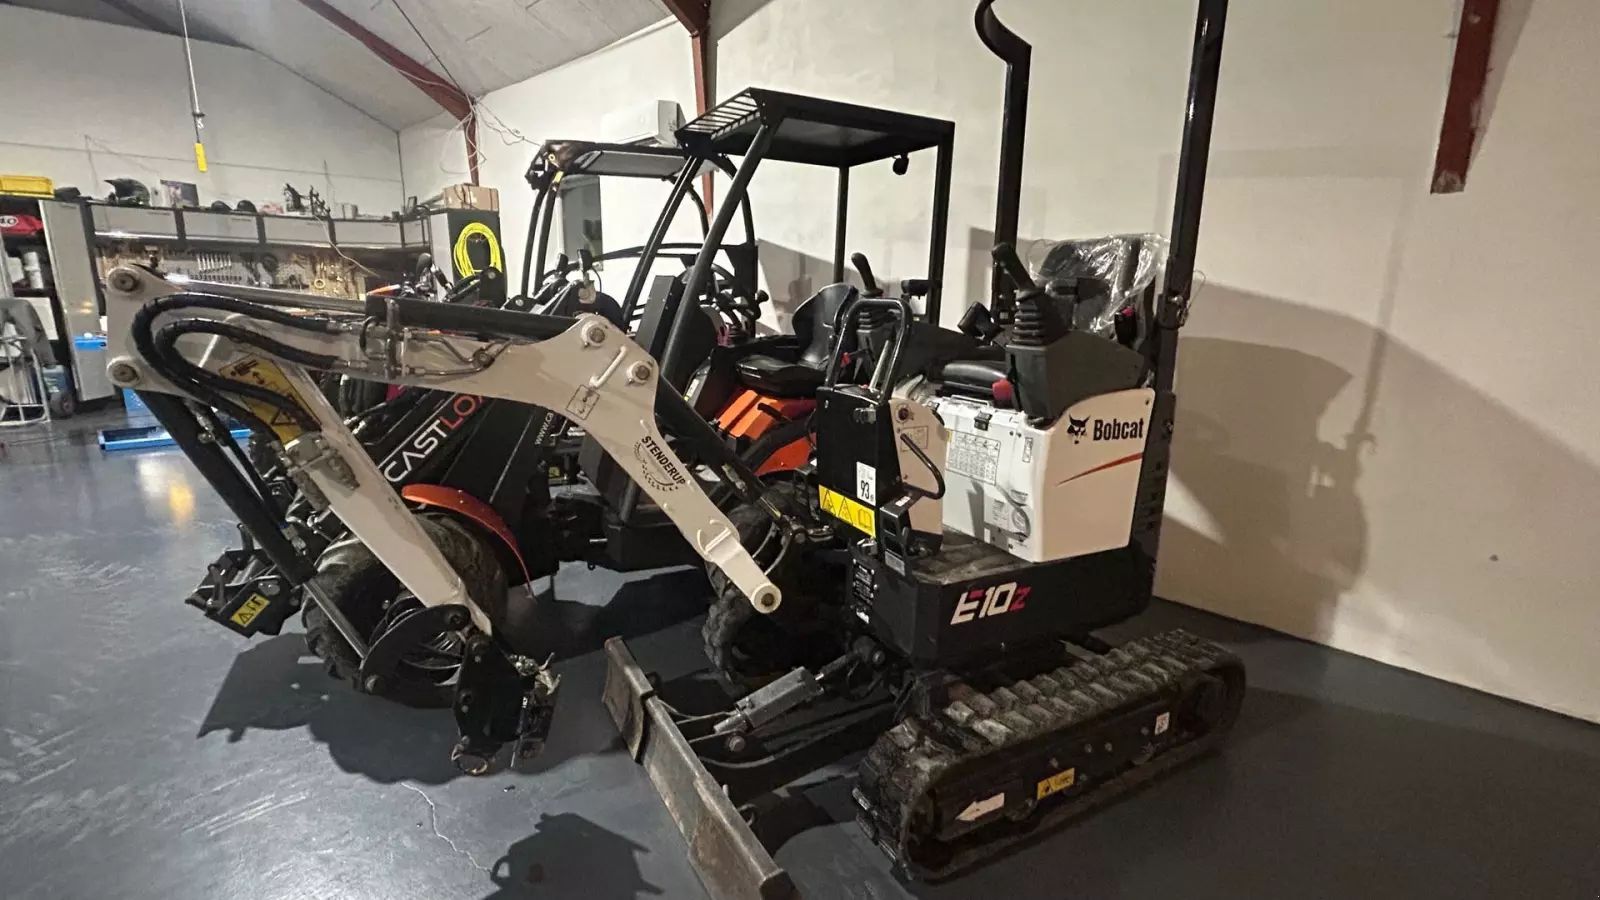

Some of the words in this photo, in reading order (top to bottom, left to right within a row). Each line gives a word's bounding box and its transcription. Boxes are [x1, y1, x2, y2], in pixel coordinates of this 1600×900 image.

[1093, 418, 1144, 441] Bobcat
[641, 435, 686, 485] STENDERUP
[860, 479, 870, 500] 93
